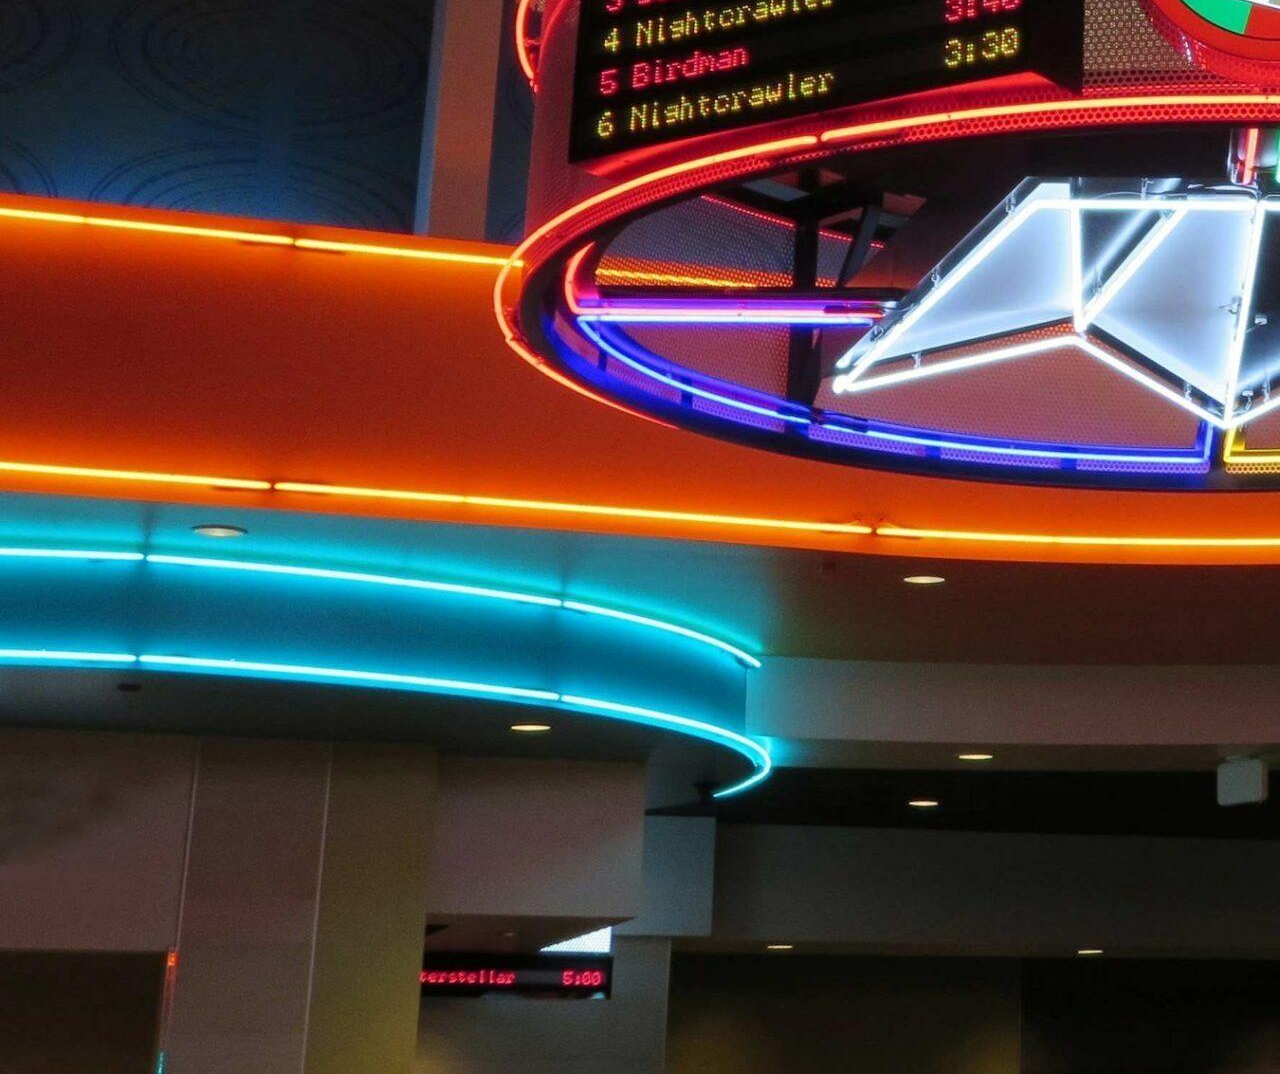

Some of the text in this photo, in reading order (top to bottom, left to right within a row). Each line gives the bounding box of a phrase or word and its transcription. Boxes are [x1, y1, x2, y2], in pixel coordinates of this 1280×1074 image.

[604, 28, 619, 51] 4
[598, 29, 1018, 136] 6 Nightcrawler 3:30
[600, 69, 618, 94] 5
[632, 48, 748, 88] Birdman
[562, 969, 604, 986] 5:00
